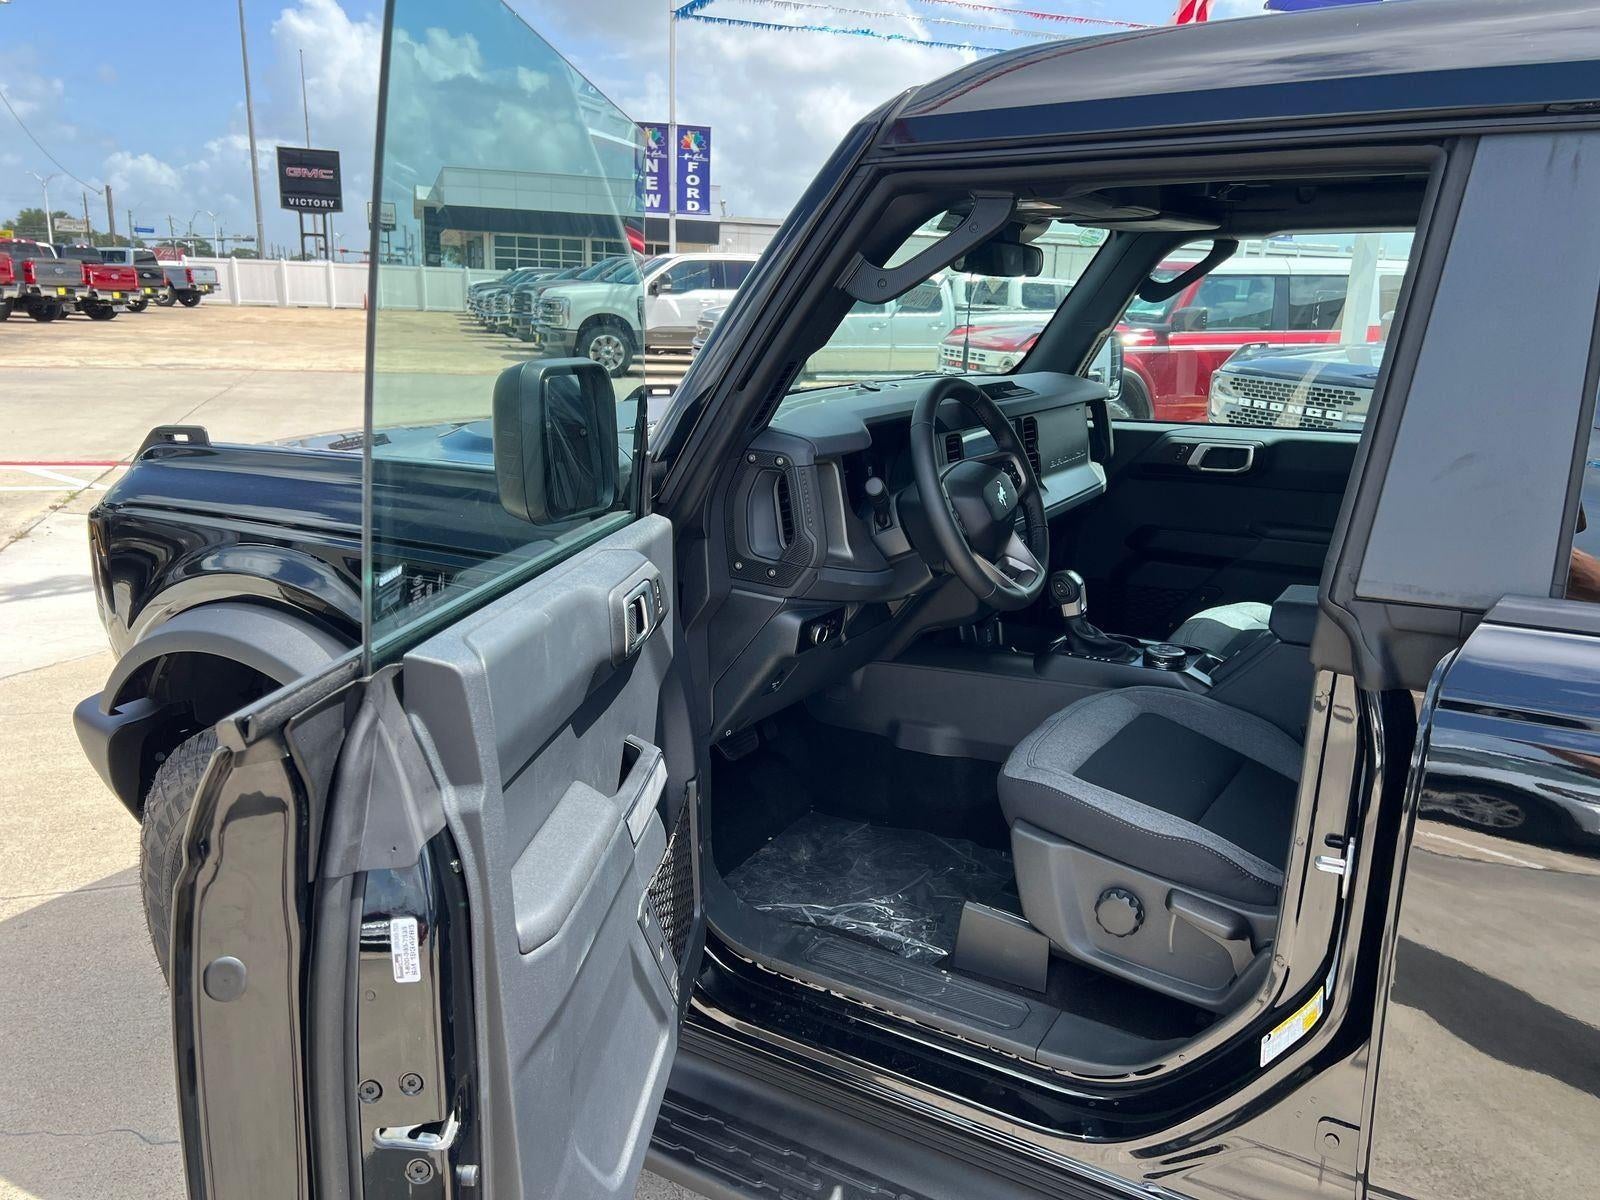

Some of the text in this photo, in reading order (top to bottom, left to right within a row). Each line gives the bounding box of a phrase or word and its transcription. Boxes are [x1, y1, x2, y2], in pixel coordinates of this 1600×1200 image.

[285, 166, 334, 180] GMC
[645, 158, 662, 208] NEW
[685, 161, 701, 212] FORD
[288, 197, 335, 208] VICTORY
[948, 360, 977, 370] FOD
[1238, 397, 1343, 421] BRONCO
